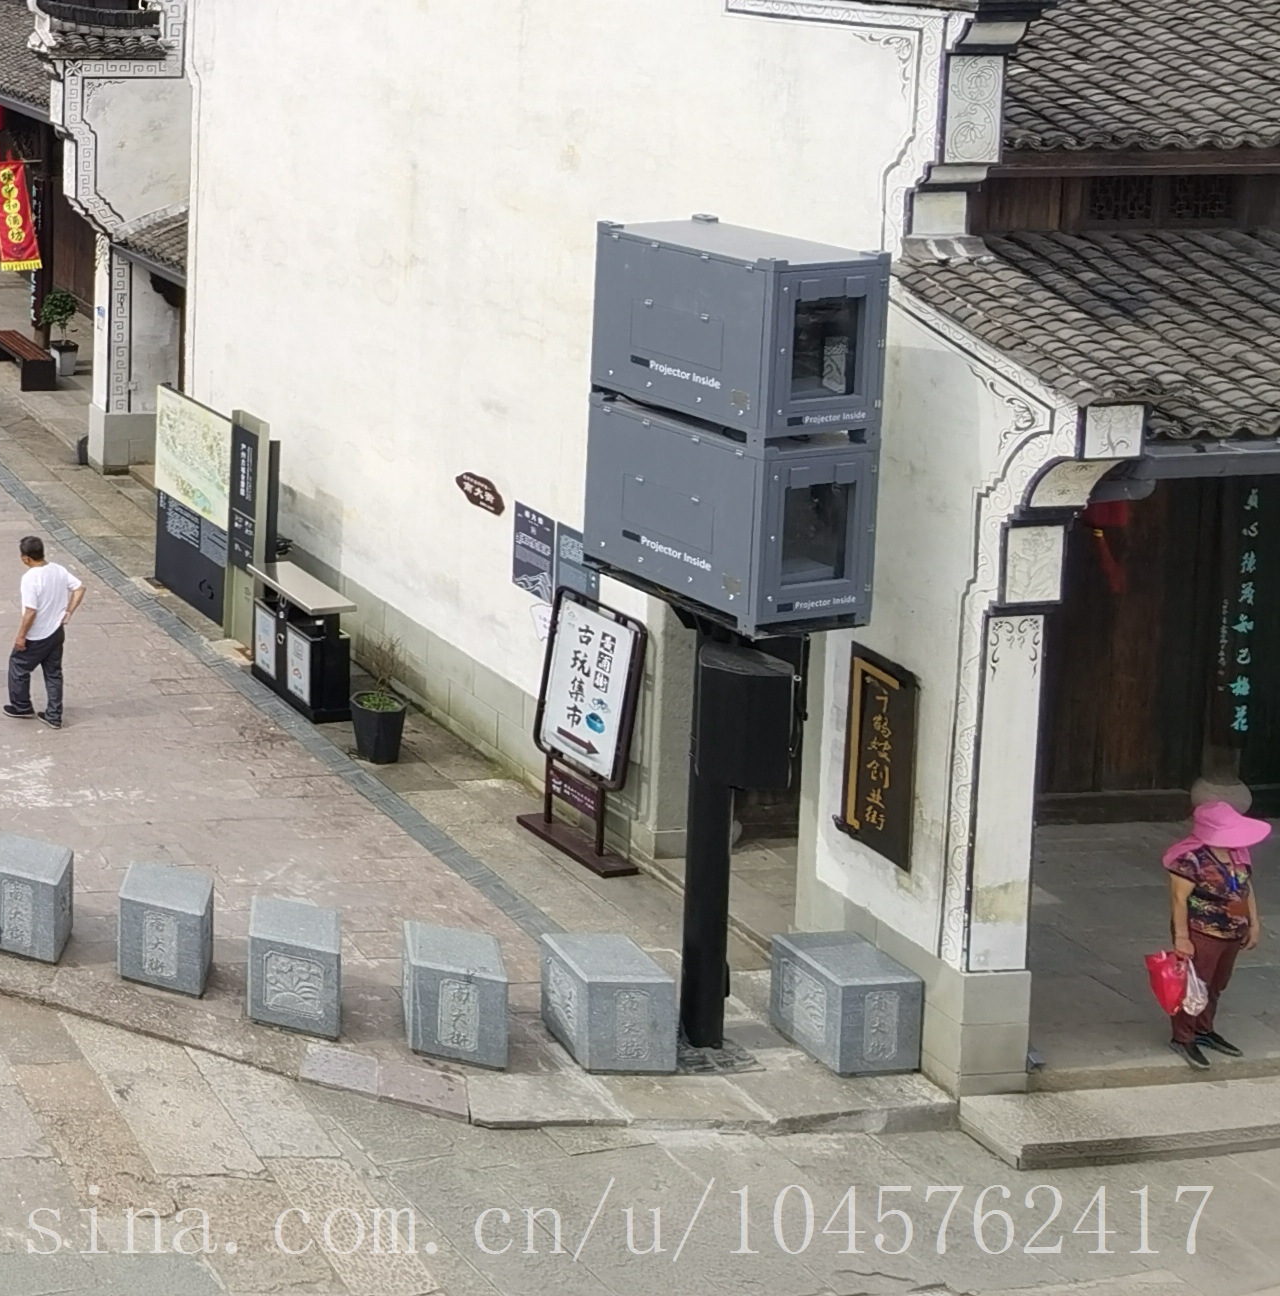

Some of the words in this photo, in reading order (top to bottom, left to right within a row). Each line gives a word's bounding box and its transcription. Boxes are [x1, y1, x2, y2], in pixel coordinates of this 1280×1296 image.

[649, 359, 691, 381] Projector
[692, 371, 722, 390] Inside
[804, 413, 841, 425] Projector
[842, 410, 867, 420] Inside
[640, 535, 682, 559] Projector
[683, 552, 712, 571] Inside
[794, 599, 832, 611] Projector
[833, 594, 856, 605] Inside
[566, 623, 596, 728] 古玩集市
